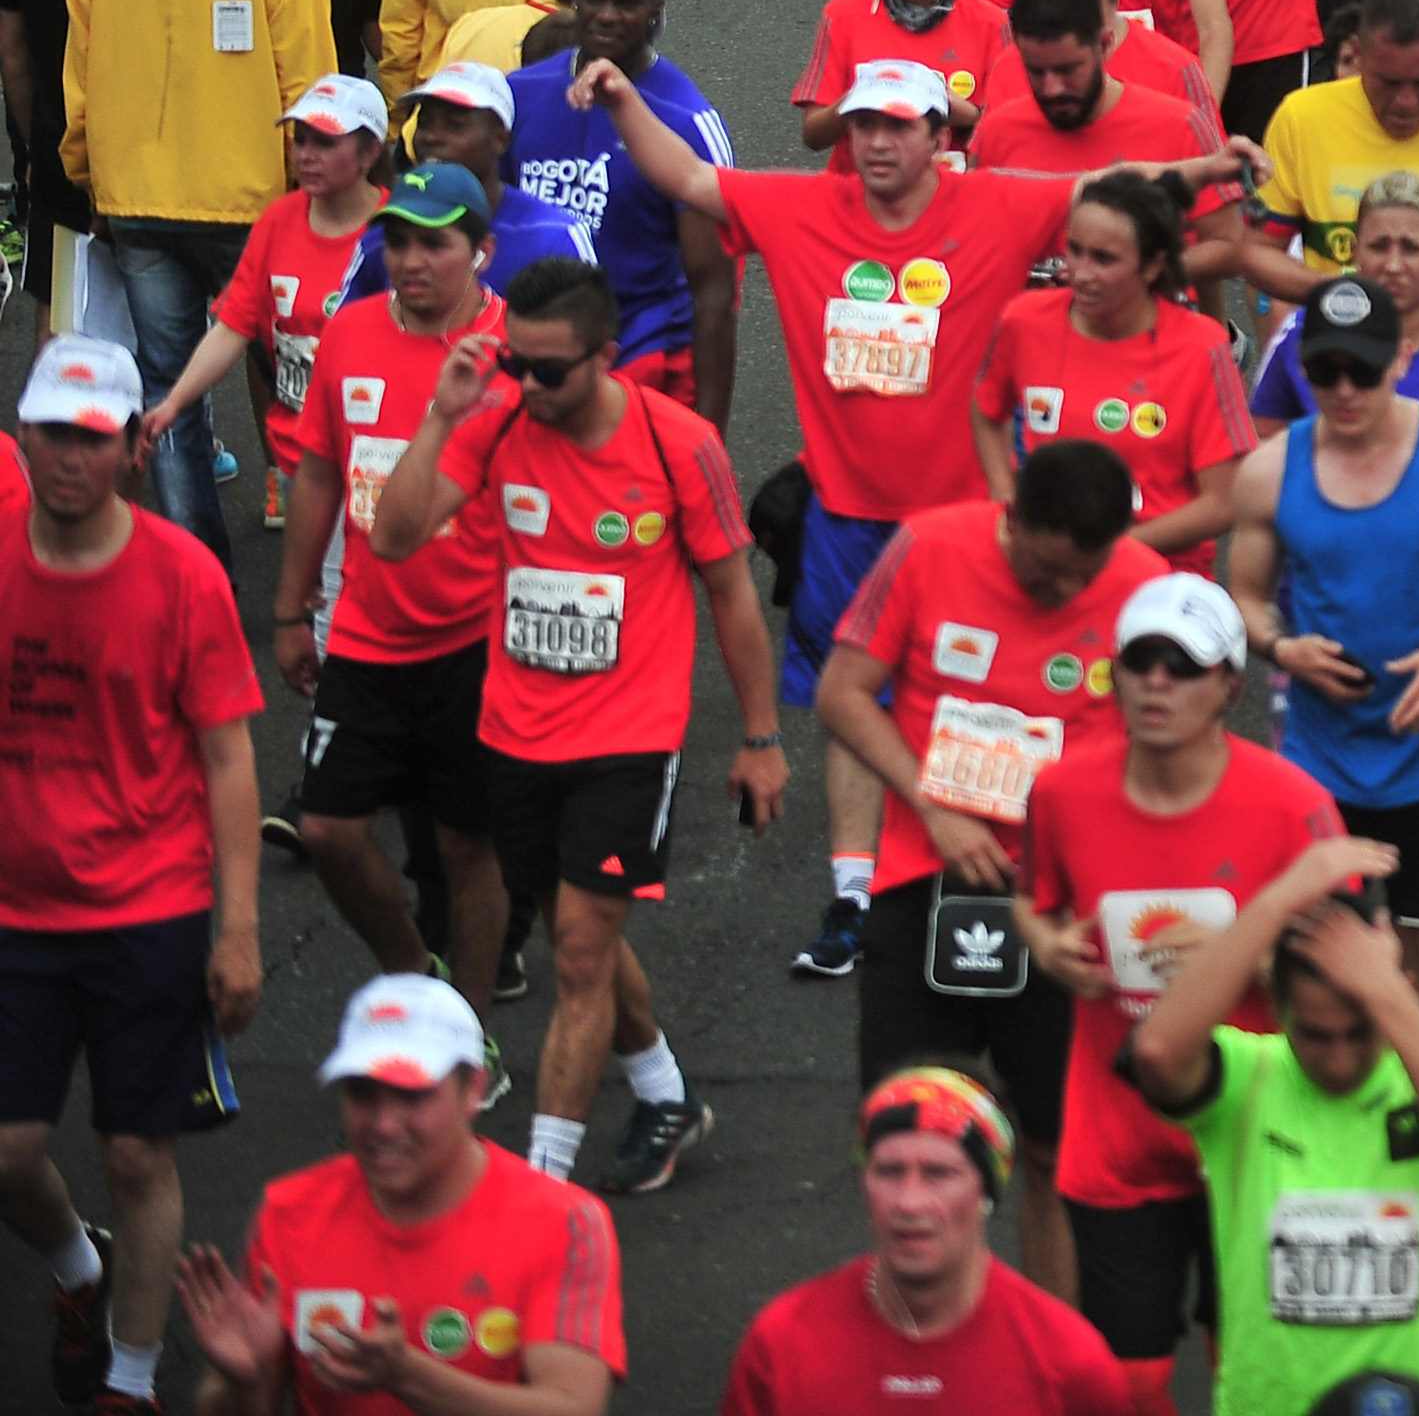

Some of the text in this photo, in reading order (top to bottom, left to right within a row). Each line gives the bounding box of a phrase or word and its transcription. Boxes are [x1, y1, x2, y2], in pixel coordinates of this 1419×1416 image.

[521, 150, 611, 189] BOGOTÁ
[519, 175, 610, 217] MEJOR
[833, 341, 928, 379] 37897
[508, 616, 612, 659] 31098
